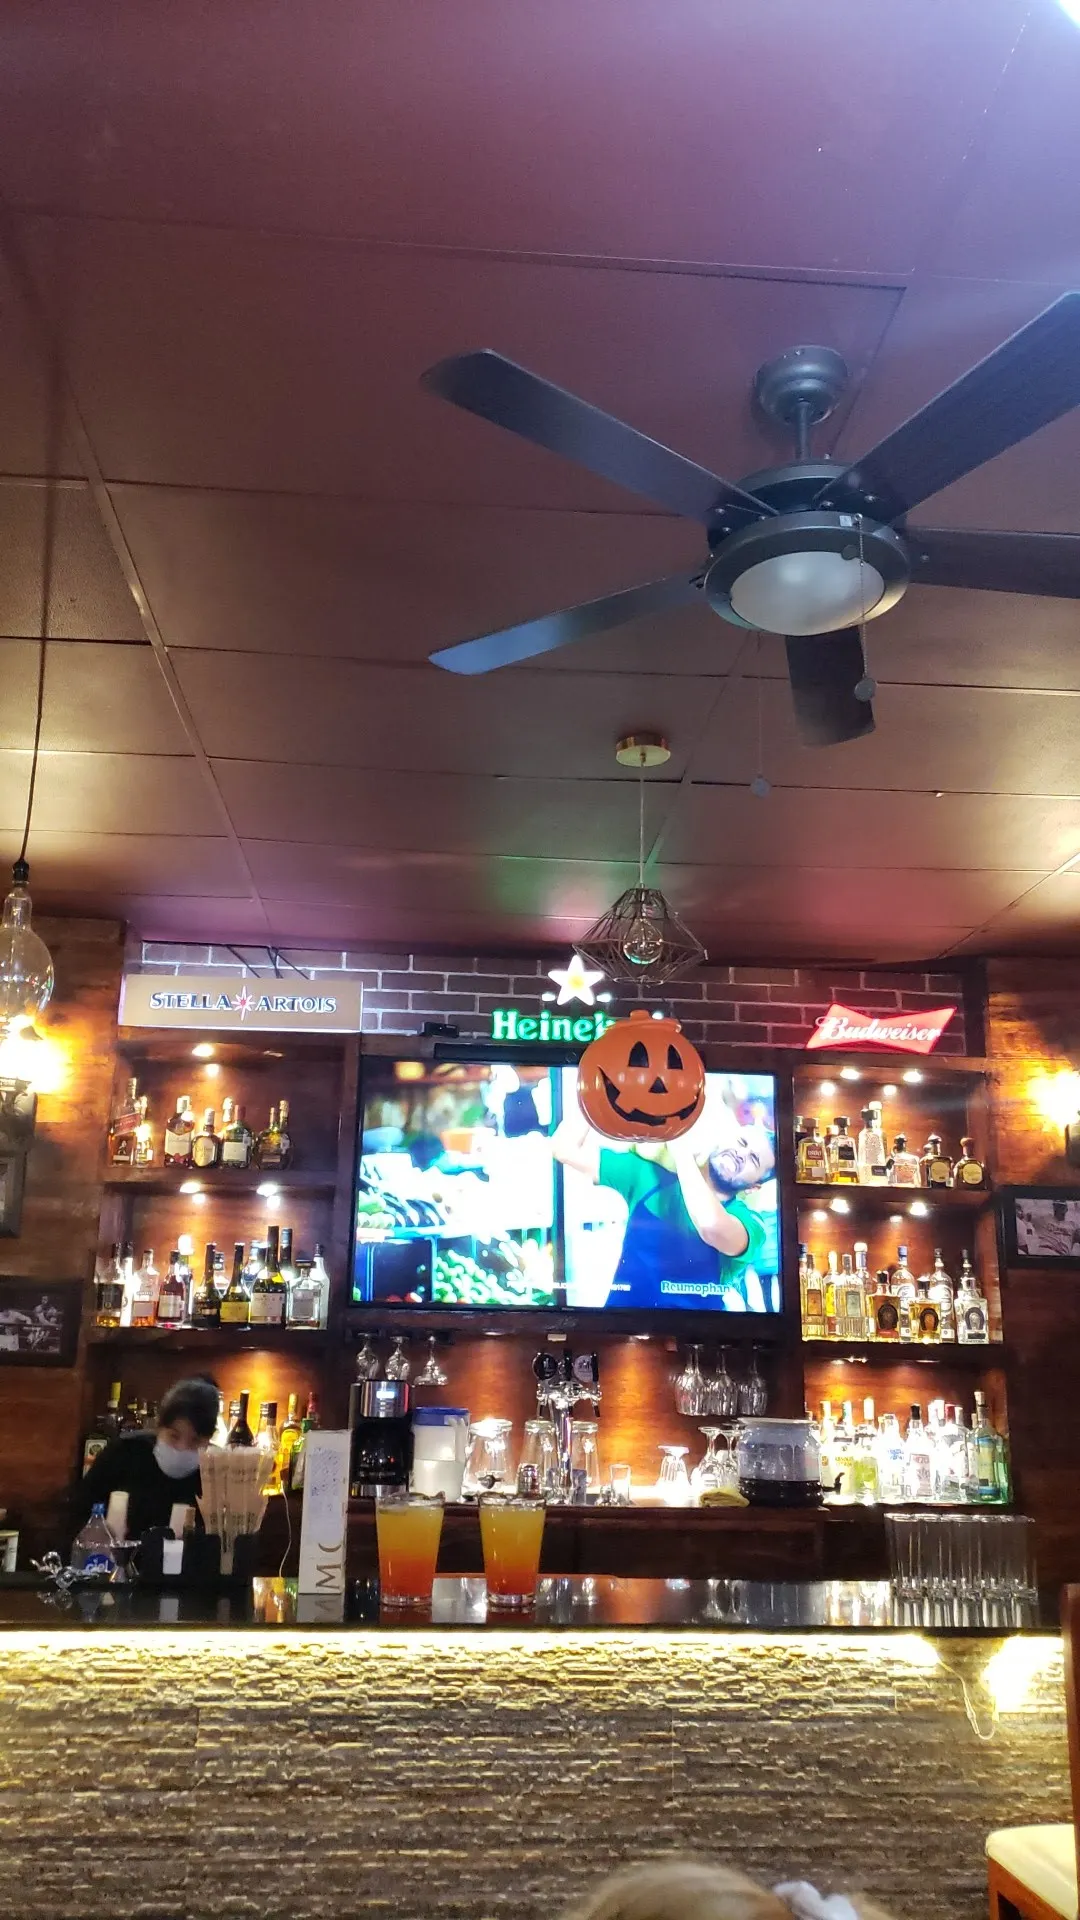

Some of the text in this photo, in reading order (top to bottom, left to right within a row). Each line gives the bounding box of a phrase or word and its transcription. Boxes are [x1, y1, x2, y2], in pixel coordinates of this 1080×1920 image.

[150, 992, 337, 1013] STELLA ARTOIS
[492, 1010, 616, 1041] Heinek
[815, 1016, 942, 1041] Budweiser
[661, 1281, 731, 1297] Reumophan
